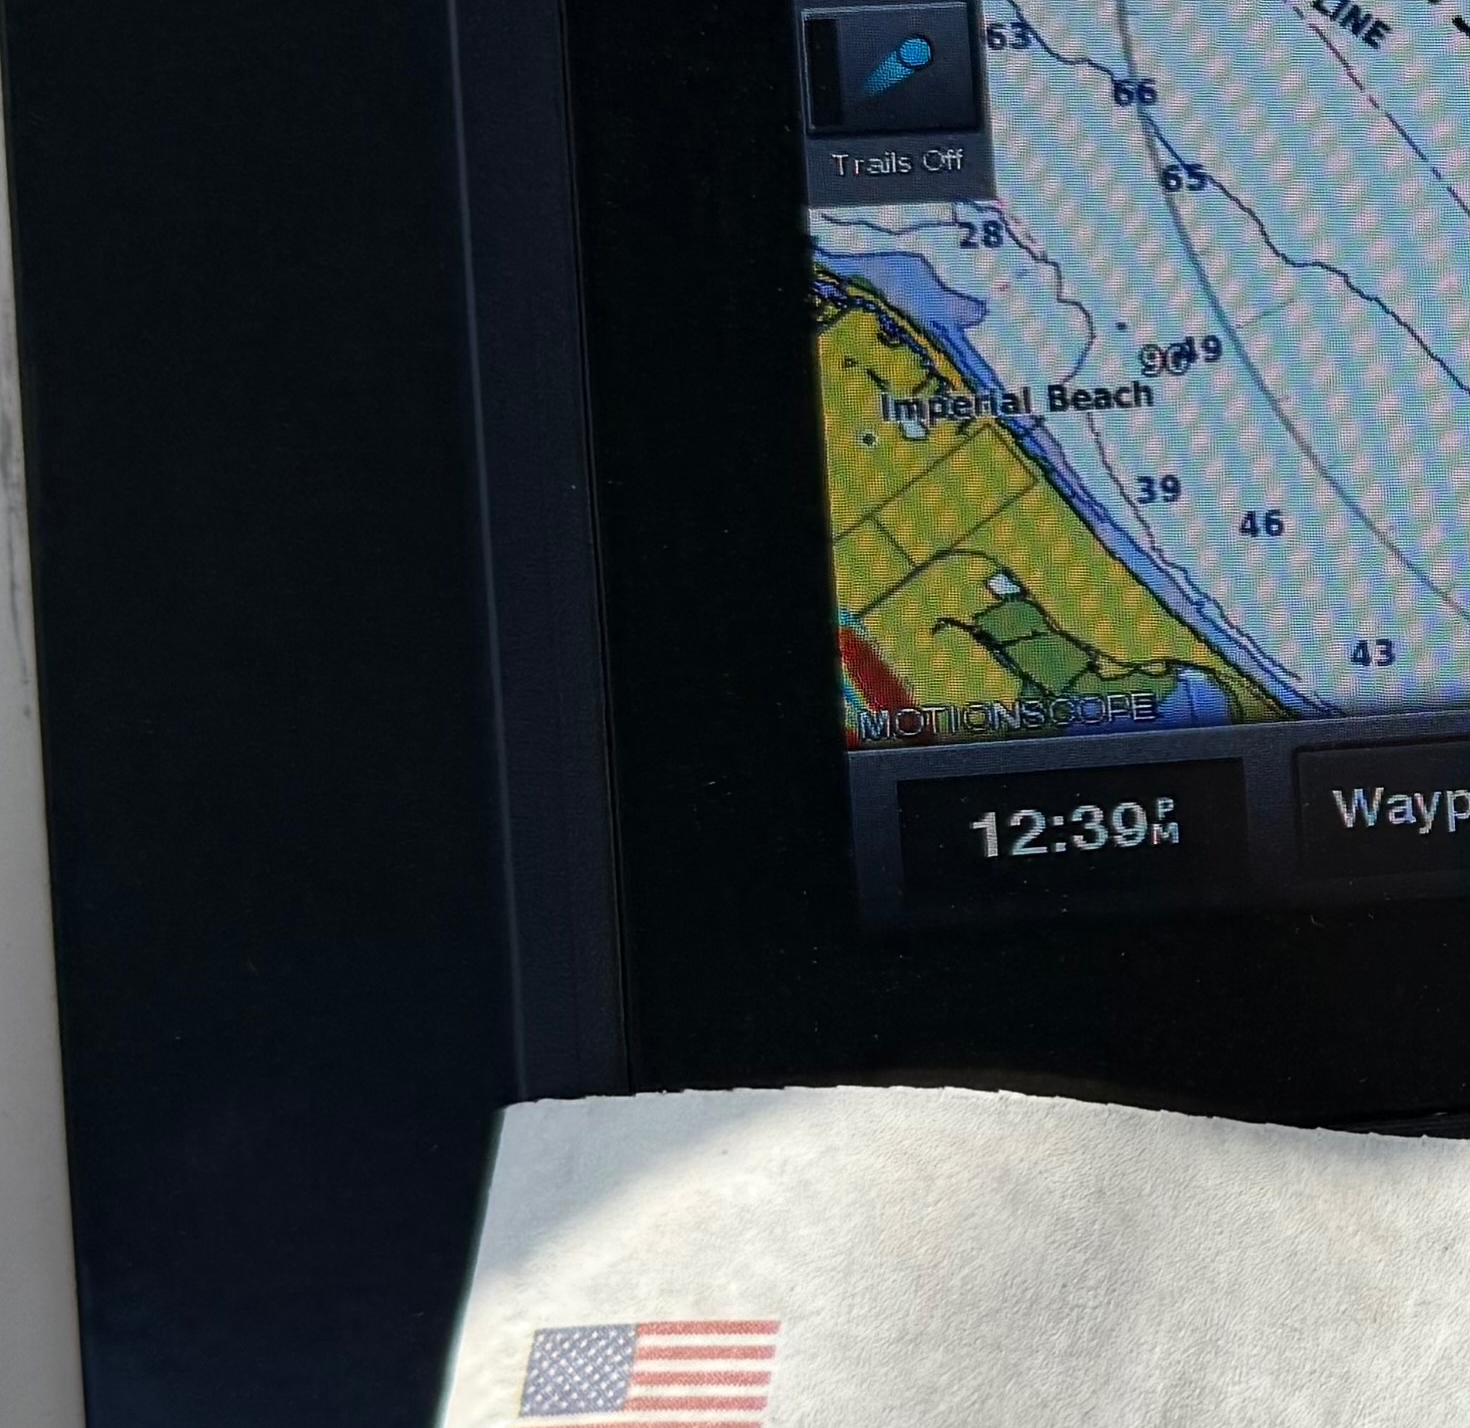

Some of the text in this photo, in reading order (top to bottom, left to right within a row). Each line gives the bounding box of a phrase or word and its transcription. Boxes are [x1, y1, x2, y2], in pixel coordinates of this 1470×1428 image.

[986, 22, 1034, 50] 63
[1113, 79, 1156, 106] 66
[832, 148, 964, 176] Trails Off
[1162, 164, 1206, 192] 65
[958, 220, 1004, 248] 28
[880, 381, 1154, 425] Imperial Beach
[1136, 474, 1181, 504] 39
[1239, 509, 1284, 537] 46
[1351, 639, 1395, 667] 43
[856, 690, 1159, 742] MOTIONSCOPE
[970, 801, 1147, 859] 12:39
